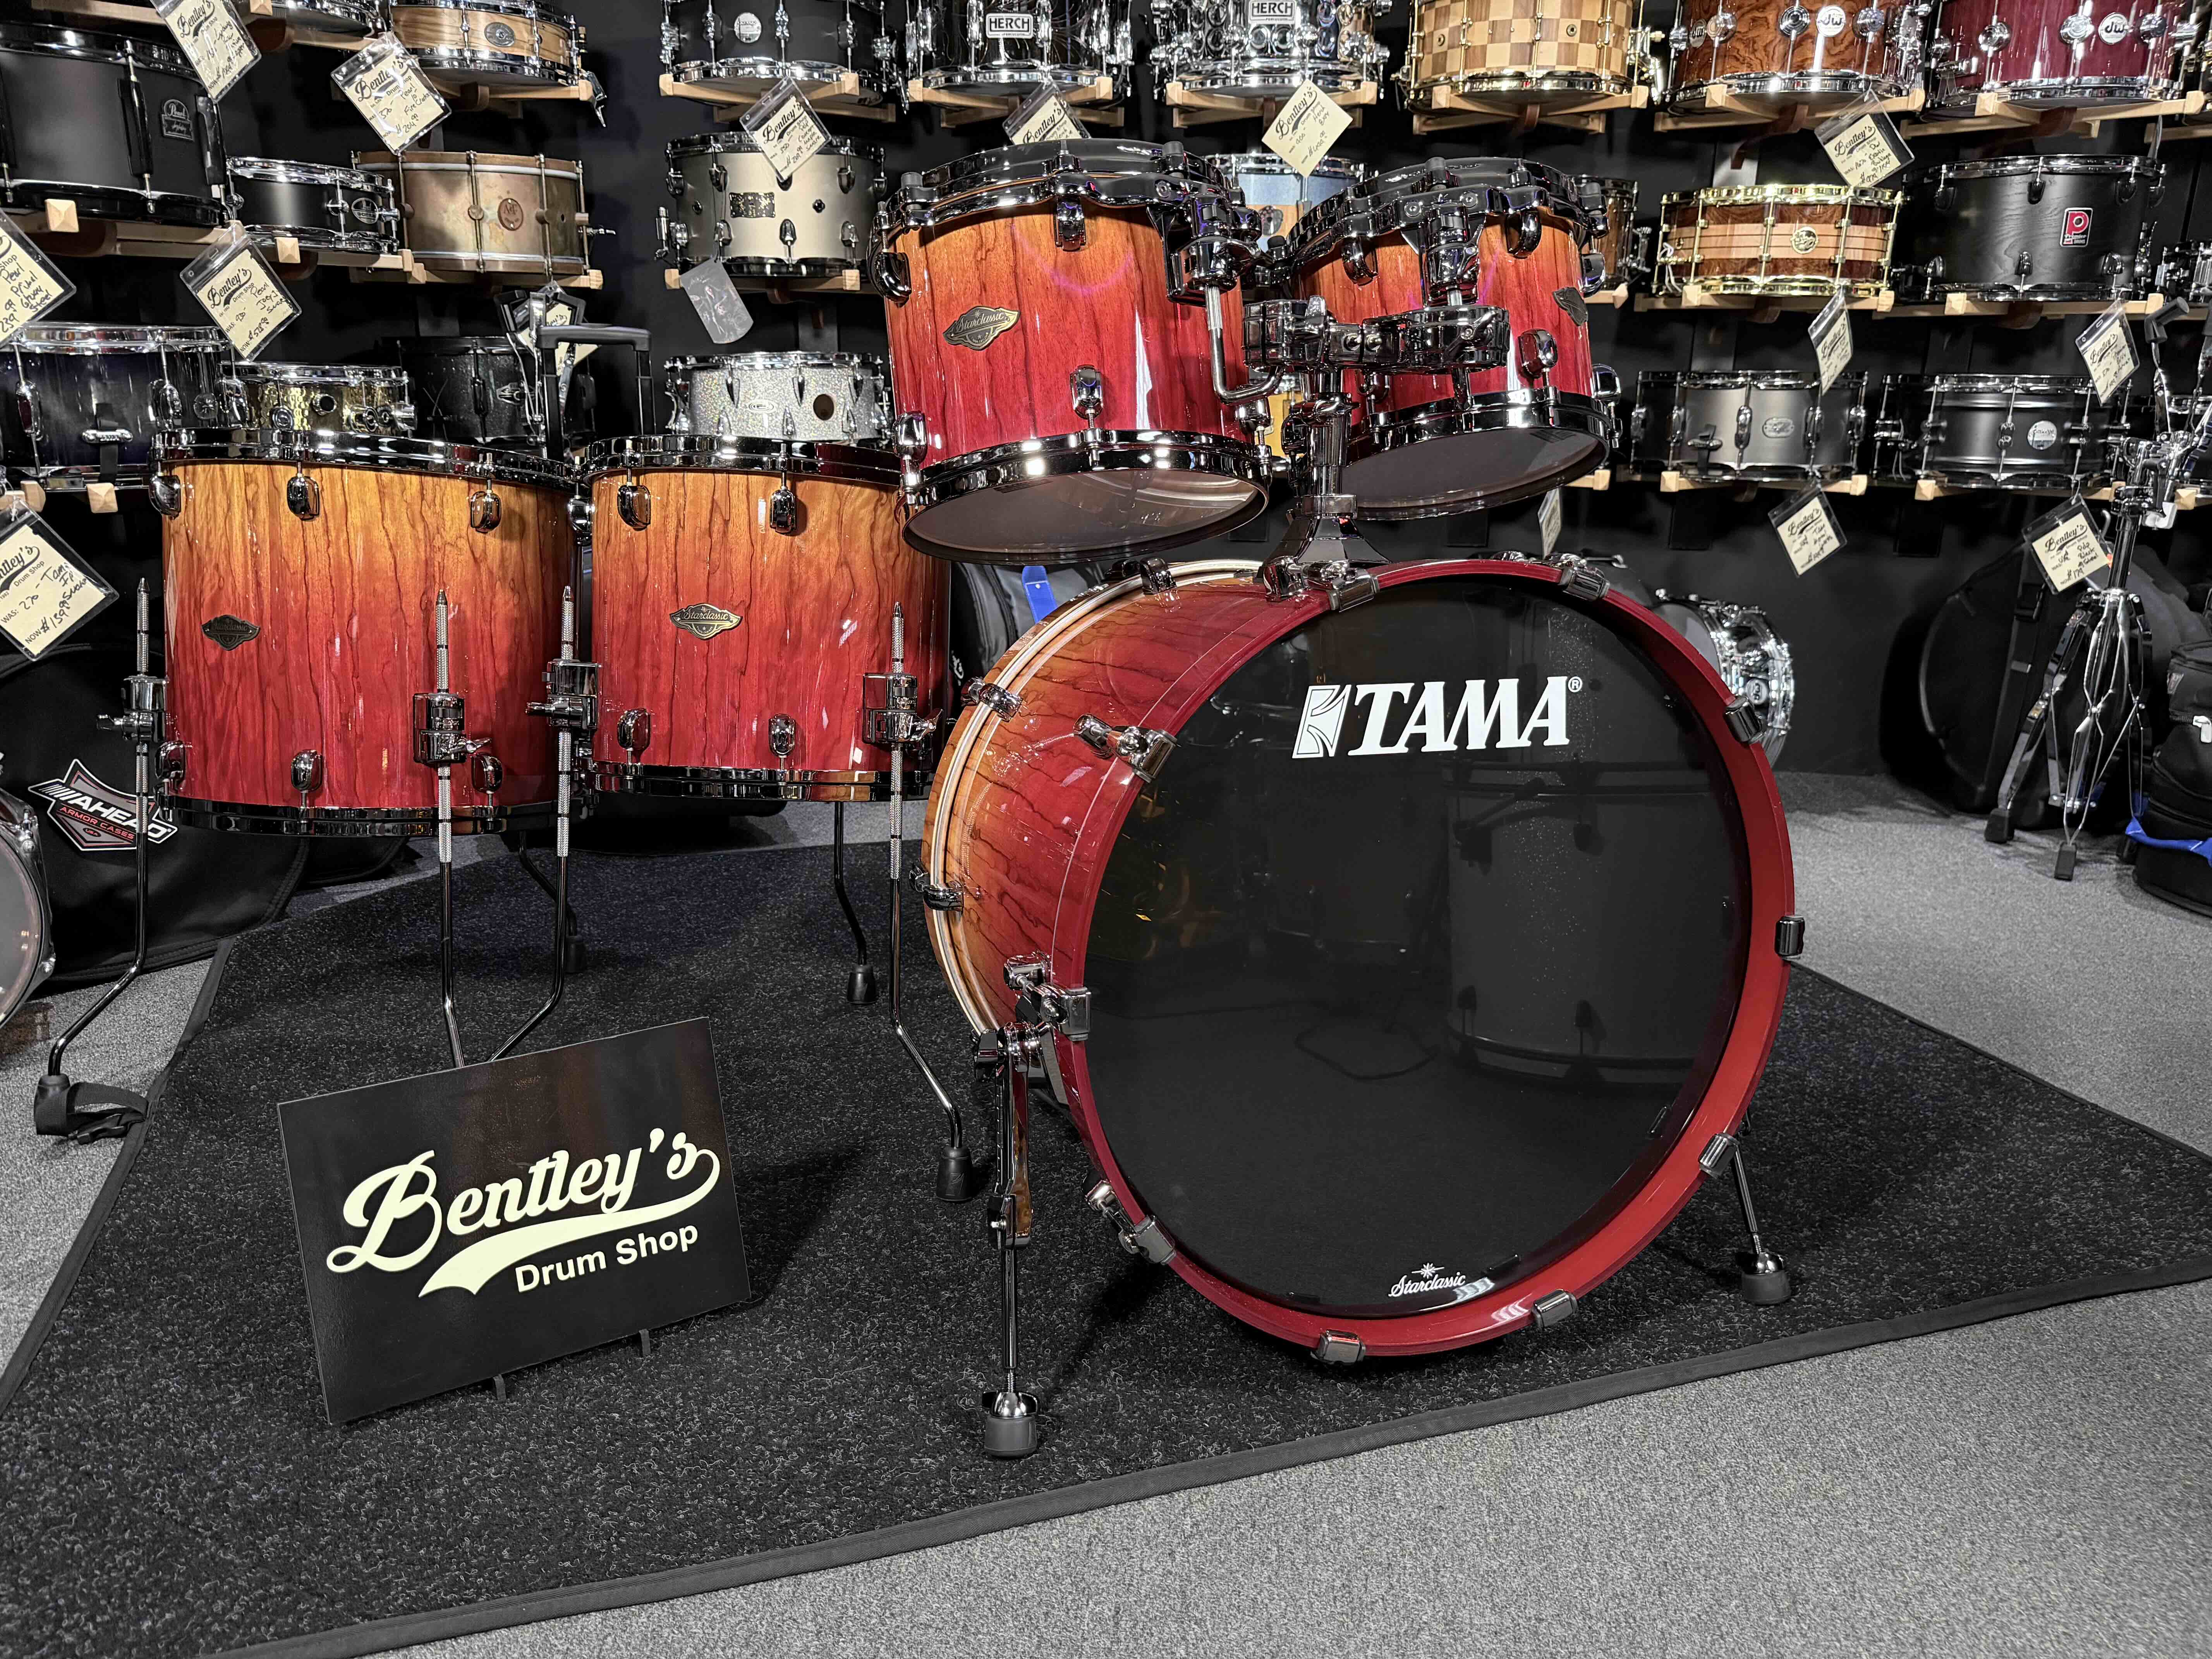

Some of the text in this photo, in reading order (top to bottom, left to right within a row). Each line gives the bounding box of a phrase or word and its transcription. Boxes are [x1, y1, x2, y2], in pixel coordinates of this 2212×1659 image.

[1252, 2, 1293, 14] HERCH
[989, 17, 1029, 29] HERCH
[2104, 21, 2124, 33] dw
[355, 60, 407, 102] Bentle's
[386, 85, 400, 96] Drum
[763, 102, 803, 144] Bentley's
[1276, 89, 1316, 140] Bentley's
[1834, 125, 1875, 158] Bentley's
[208, 268, 251, 309] Bentley's
[232, 282, 255, 303] Drum Shop
[956, 312, 1004, 332] Starclassic
[2045, 524, 2086, 553] Bentley's
[0, 546, 37, 580] ntley's
[13, 560, 45, 587] Drum Shop
[2, 608, 19, 624] WAS:
[683, 607, 729, 620] Starclassic
[60, 806, 135, 840] ARMOR CASES
[85, 828, 98, 836] USA
[326, 1128, 713, 1274] Bentley's
[515, 1225, 698, 1293] Drum Shop
[1388, 1271, 1466, 1297] Starclassic
